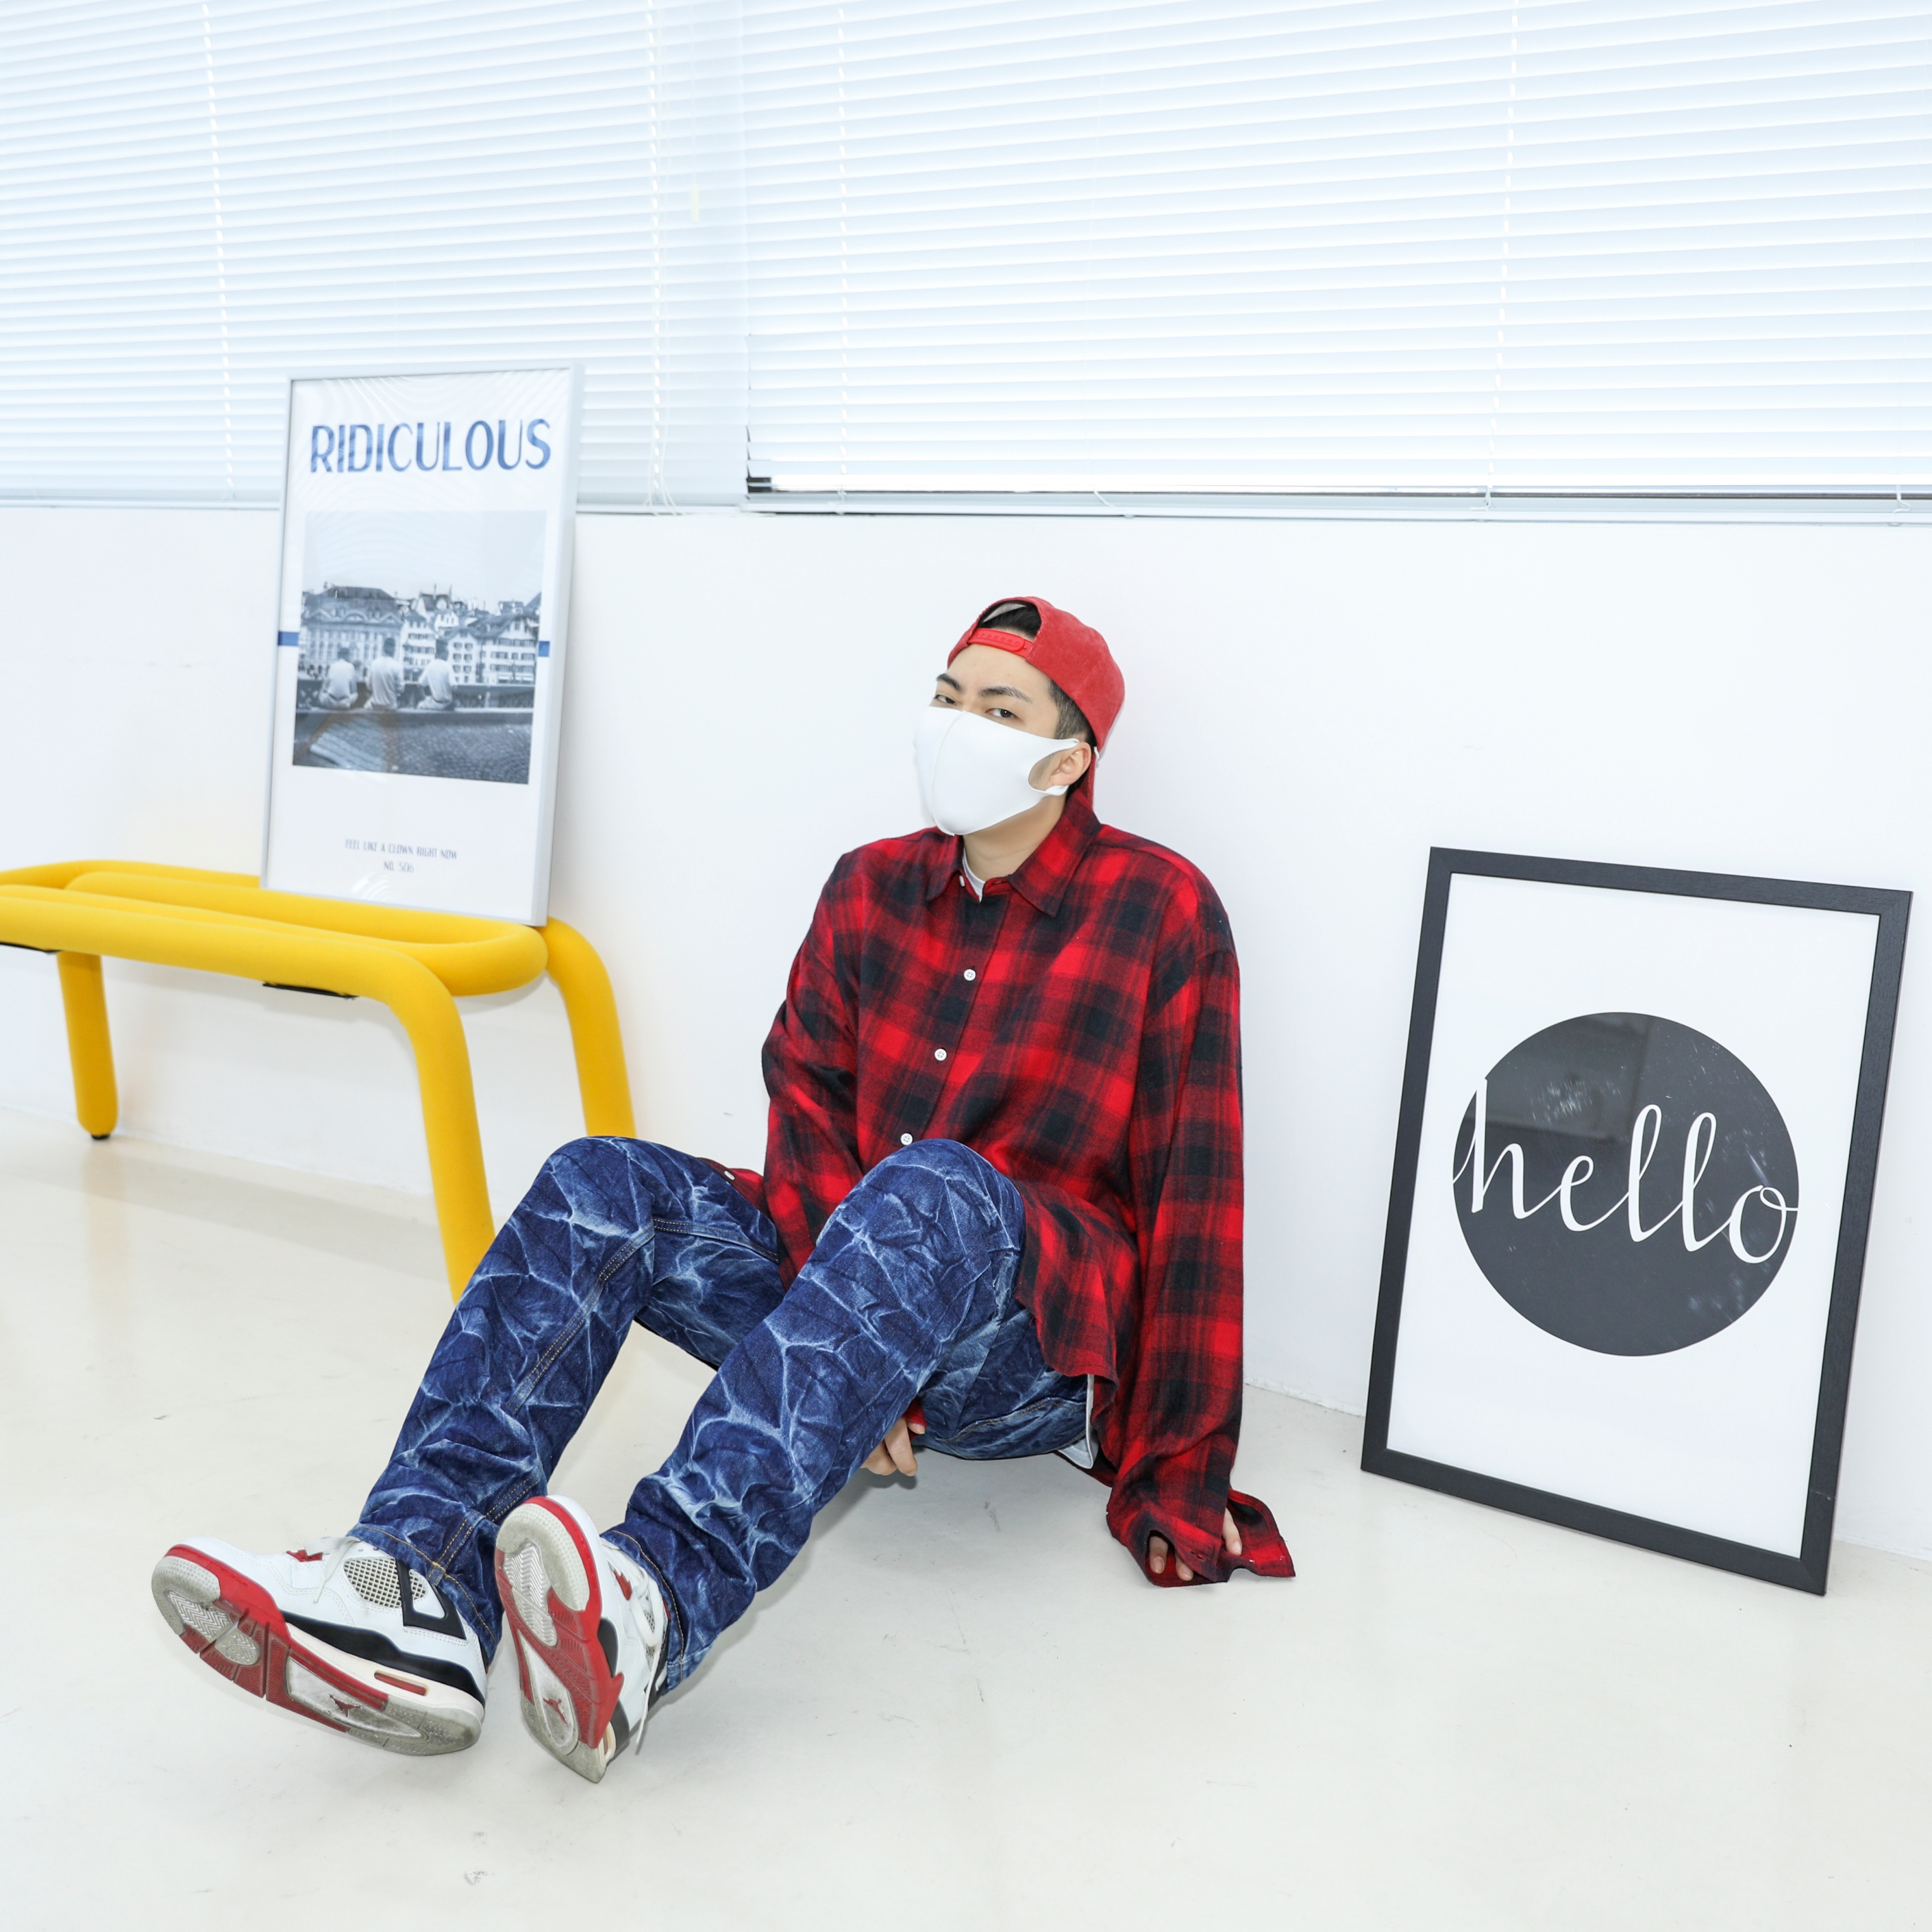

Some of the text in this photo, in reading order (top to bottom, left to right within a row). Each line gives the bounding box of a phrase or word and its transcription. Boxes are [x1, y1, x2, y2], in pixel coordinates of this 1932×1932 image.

[310, 419, 551, 473] RIDICULOUS
[345, 839, 458, 860] FEEL LIKE A CLOWN RIGHT NOW
[384, 861, 414, 874] NO. 506
[1452, 1078, 1800, 1264] hello
